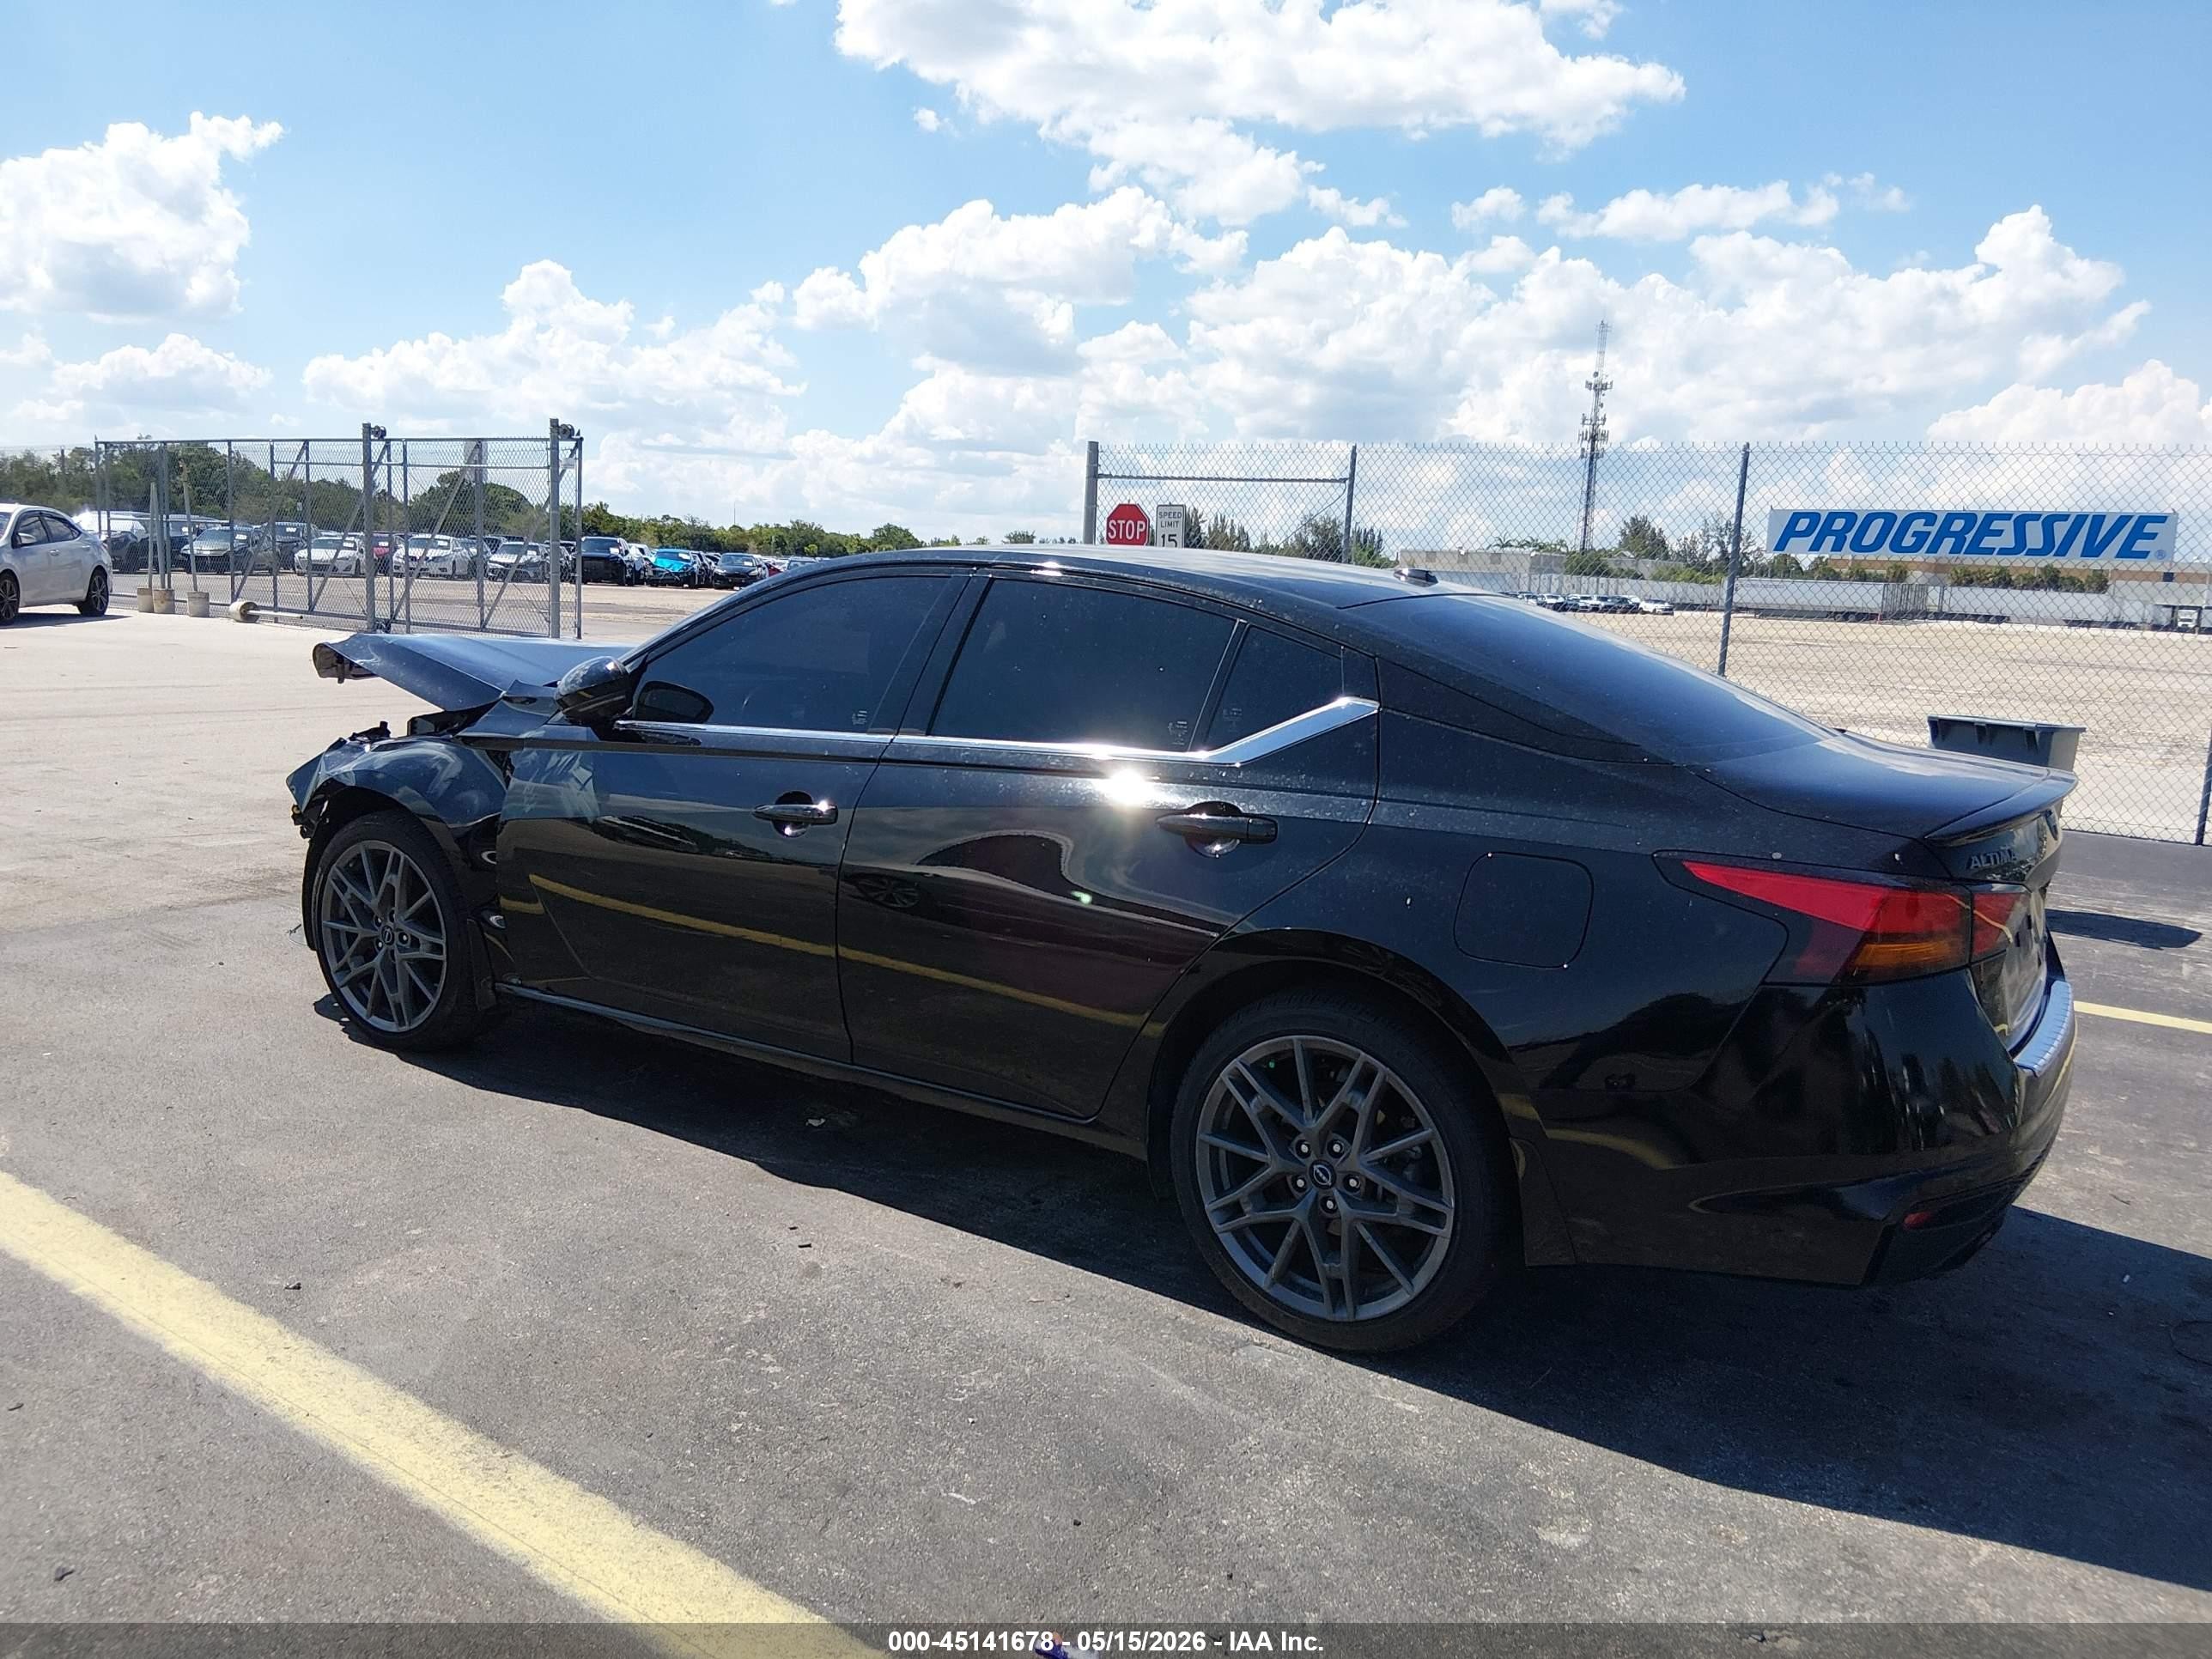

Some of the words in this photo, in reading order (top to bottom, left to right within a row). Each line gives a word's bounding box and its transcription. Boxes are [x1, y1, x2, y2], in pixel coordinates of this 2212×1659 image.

[1108, 520, 1146, 539] STOP
[1772, 511, 2168, 559] PROGRESSIVE
[1161, 533, 1178, 548] 15
